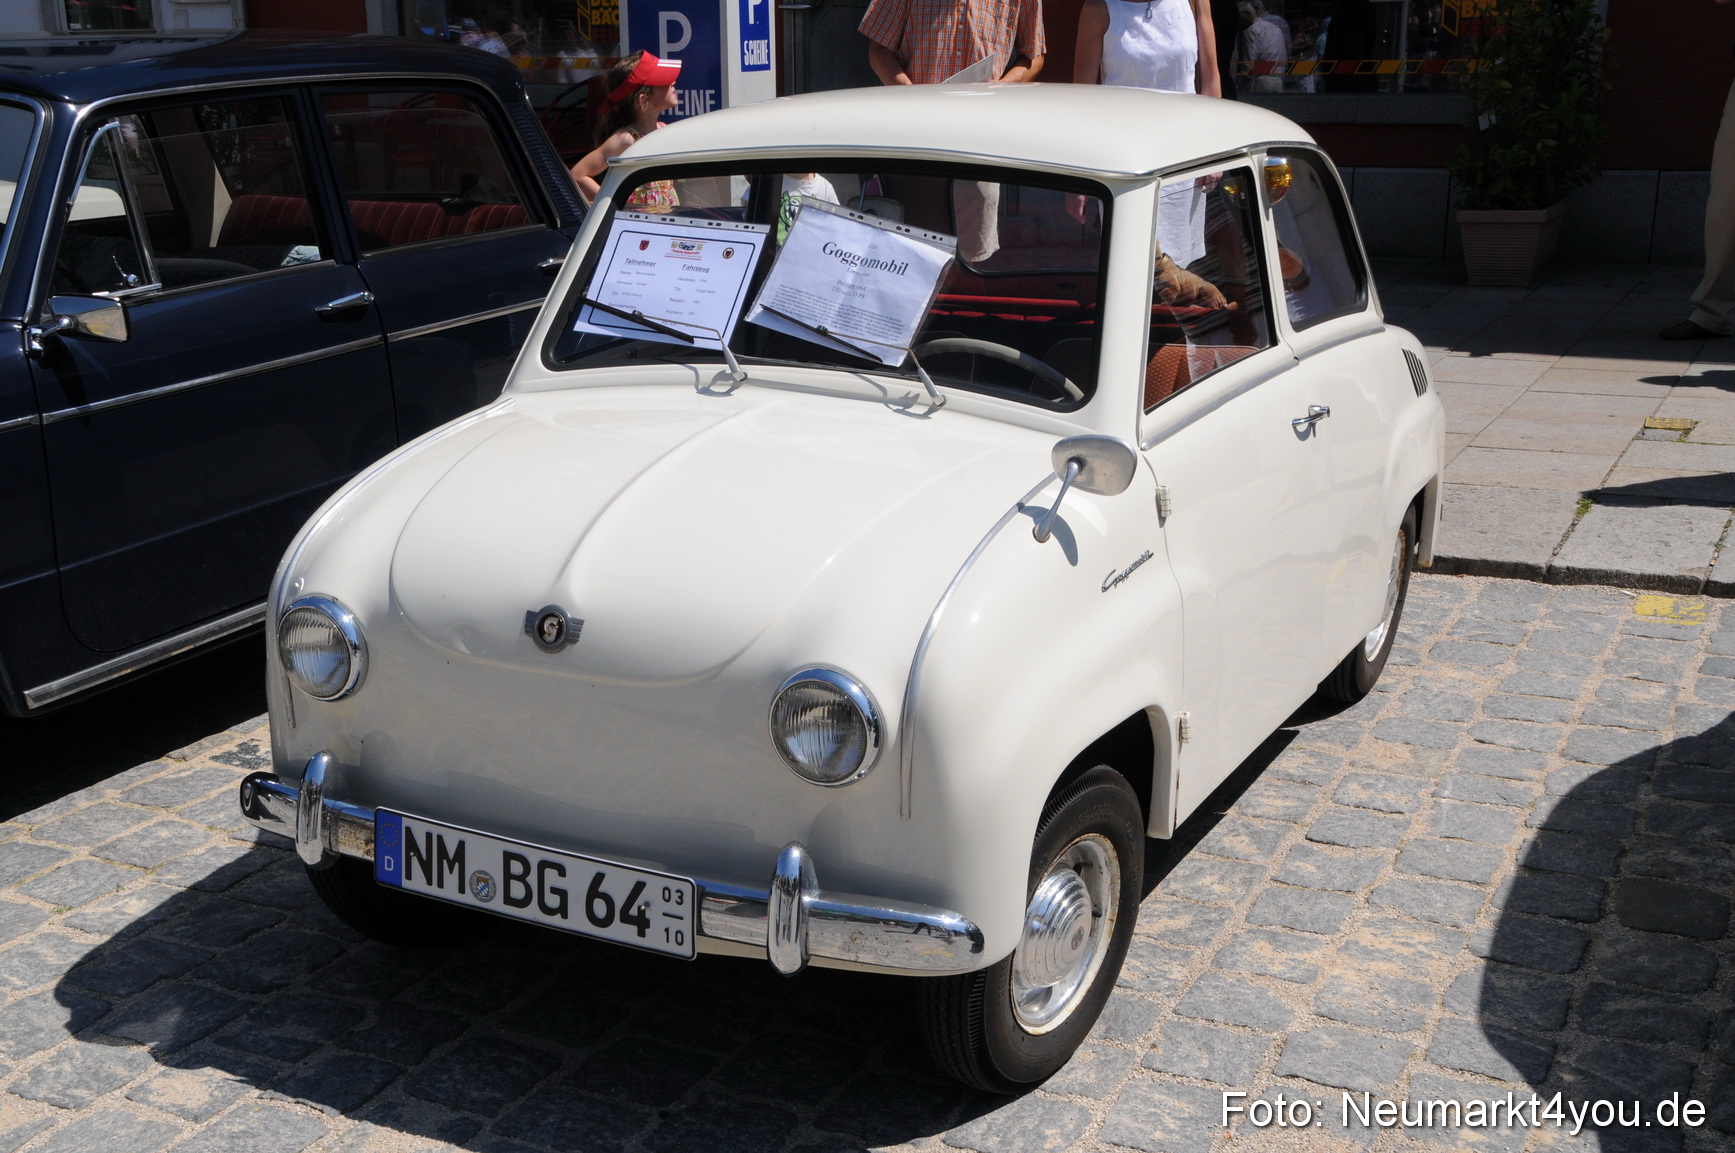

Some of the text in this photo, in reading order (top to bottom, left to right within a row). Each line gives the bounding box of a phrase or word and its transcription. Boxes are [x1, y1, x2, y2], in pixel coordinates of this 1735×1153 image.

[748, 0, 762, 24] P
[658, 11, 692, 59] P
[744, 39, 768, 65] SCHEINE
[661, 89, 716, 115] EINE
[625, 258, 657, 267] Teilnehmer
[682, 264, 710, 273] Fahrzeug
[822, 241, 909, 276] Goggomobil
[384, 856, 394, 872] D
[404, 826, 466, 895] NM
[502, 850, 569, 920] BG
[585, 872, 651, 938] 64
[661, 886, 684, 906] 03
[664, 927, 684, 947] 10
